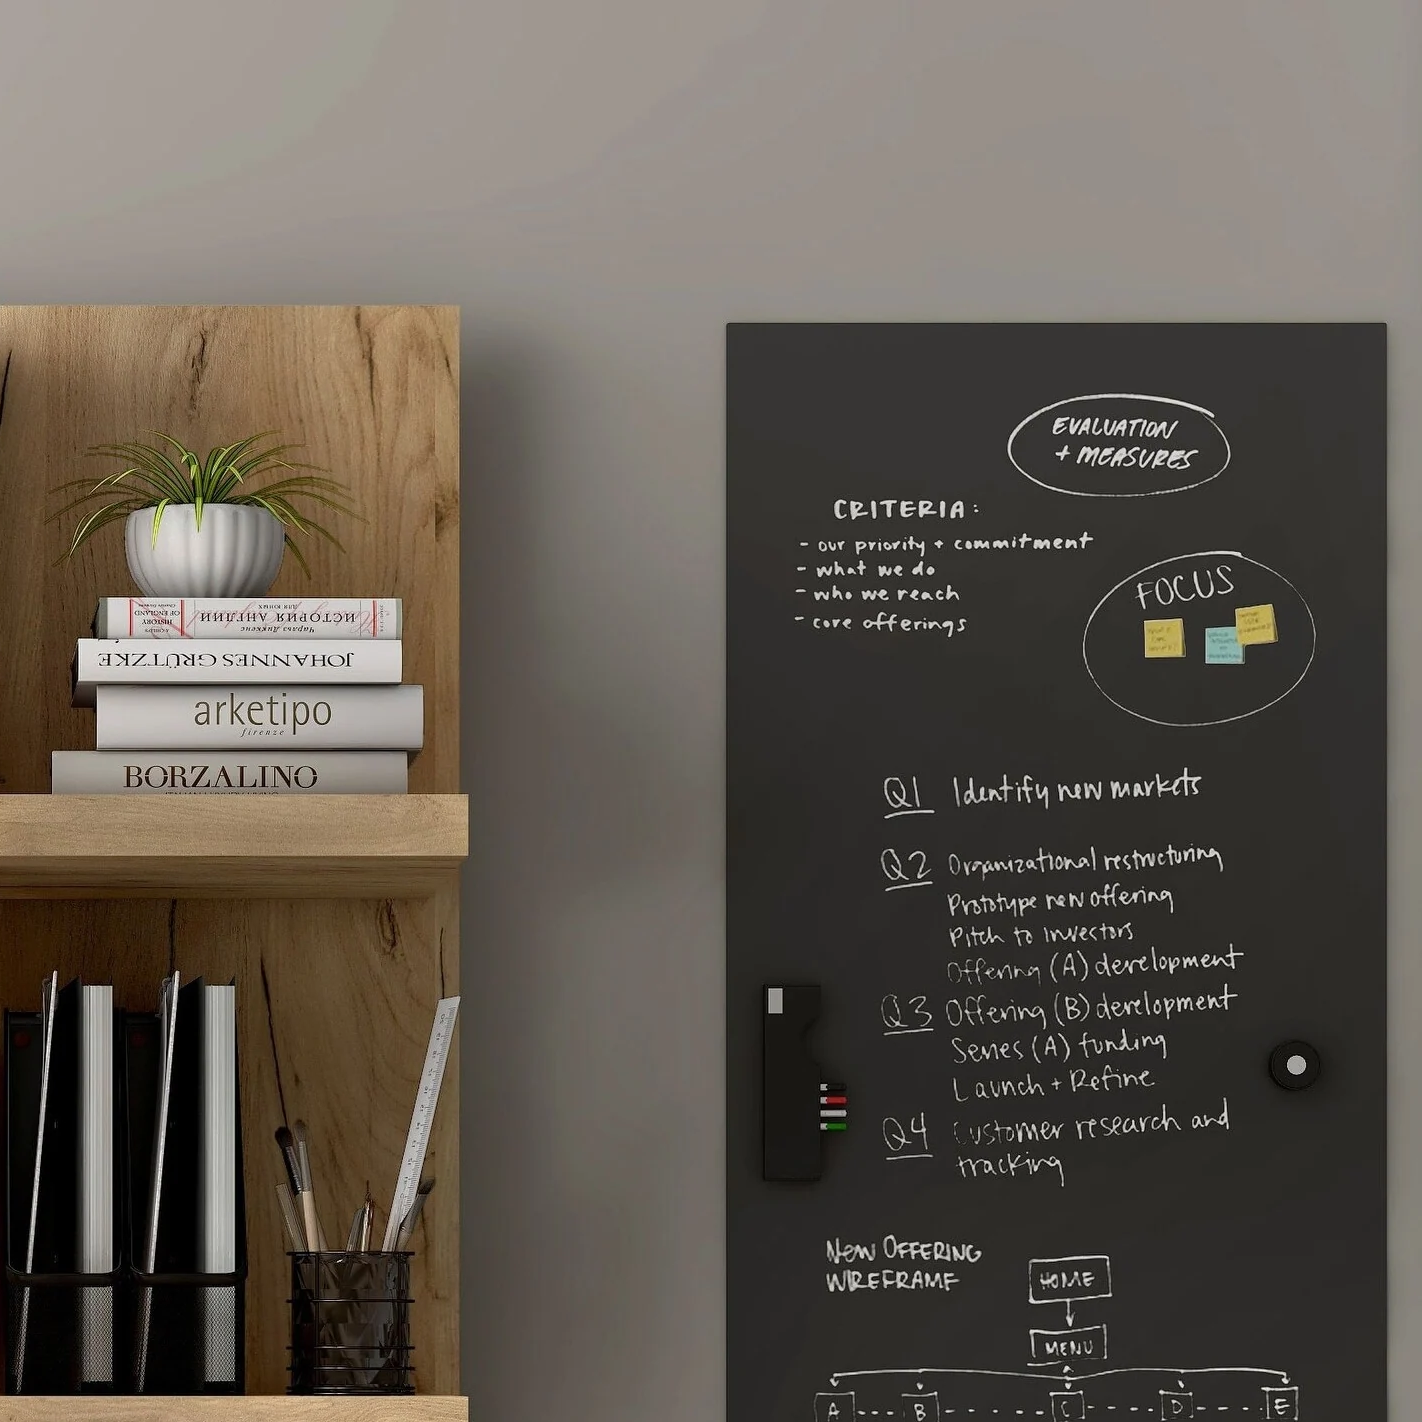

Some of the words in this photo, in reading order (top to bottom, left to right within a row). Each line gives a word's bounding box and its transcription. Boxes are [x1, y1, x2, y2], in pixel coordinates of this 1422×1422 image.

[1051, 416, 1180, 440] EVALUATION
[1076, 445, 1200, 471] MEASURES
[818, 540, 846, 553] our
[854, 535, 926, 558] priority
[953, 531, 1094, 551] commitment
[816, 559, 867, 578] what
[877, 564, 903, 578] we
[911, 560, 936, 577] do
[813, 584, 853, 601] who
[861, 588, 890, 602] we
[897, 584, 961, 601] reach
[1134, 564, 1235, 610] FOCUS
[200, 612, 267, 623] АНГЛИИ
[277, 612, 357, 623] ИСТОРИЯ
[812, 617, 852, 630] core
[862, 611, 967, 638] offerings
[98, 652, 218, 669] GRÜTZKE
[222, 652, 355, 669] JOHANNES
[194, 693, 332, 736] arketipo
[240, 728, 286, 738] firenze
[123, 765, 319, 790] BORZALINO
[883, 775, 922, 809] Q1
[953, 773, 1049, 810] Identify
[1057, 781, 1102, 802] new
[1109, 766, 1202, 799] markets
[880, 848, 933, 882] Q2
[948, 846, 1097, 882] Organizational
[1103, 843, 1225, 873] restructuring
[947, 892, 1037, 918] Prototype
[1045, 891, 1085, 911] new
[1089, 882, 1174, 914] offering
[949, 925, 1006, 948] Pitch
[1013, 926, 1034, 947] to
[947, 957, 1041, 986] Offering
[1049, 949, 1089, 984] (A)
[1094, 943, 1245, 977] development
[880, 994, 933, 1028] Q3
[945, 994, 1047, 1030] Offering
[1053, 992, 1091, 1027] (B)
[1096, 982, 1239, 1020] development
[951, 1037, 1025, 1064] Series
[1031, 1032, 1071, 1064] (A)
[1078, 1028, 1167, 1060] funding
[953, 1073, 1045, 1102] Launch
[1069, 1064, 1156, 1093] Refine
[882, 1111, 928, 1151] Q4
[953, 1119, 1065, 1146] Customer
[1075, 1103, 1182, 1141] research
[1191, 1097, 1230, 1131] and
[957, 1151, 1065, 1188] tracking
[883, 1234, 983, 1263] OFFERING
[1039, 1271, 1095, 1290] HOME
[1044, 1339, 1095, 1357] MENU
[827, 1402, 841, 1422] A
[913, 1403, 927, 1422] B
[1060, 1400, 1070, 1418] C
[1171, 1399, 1184, 1415] D
[1273, 1398, 1291, 1416] E
